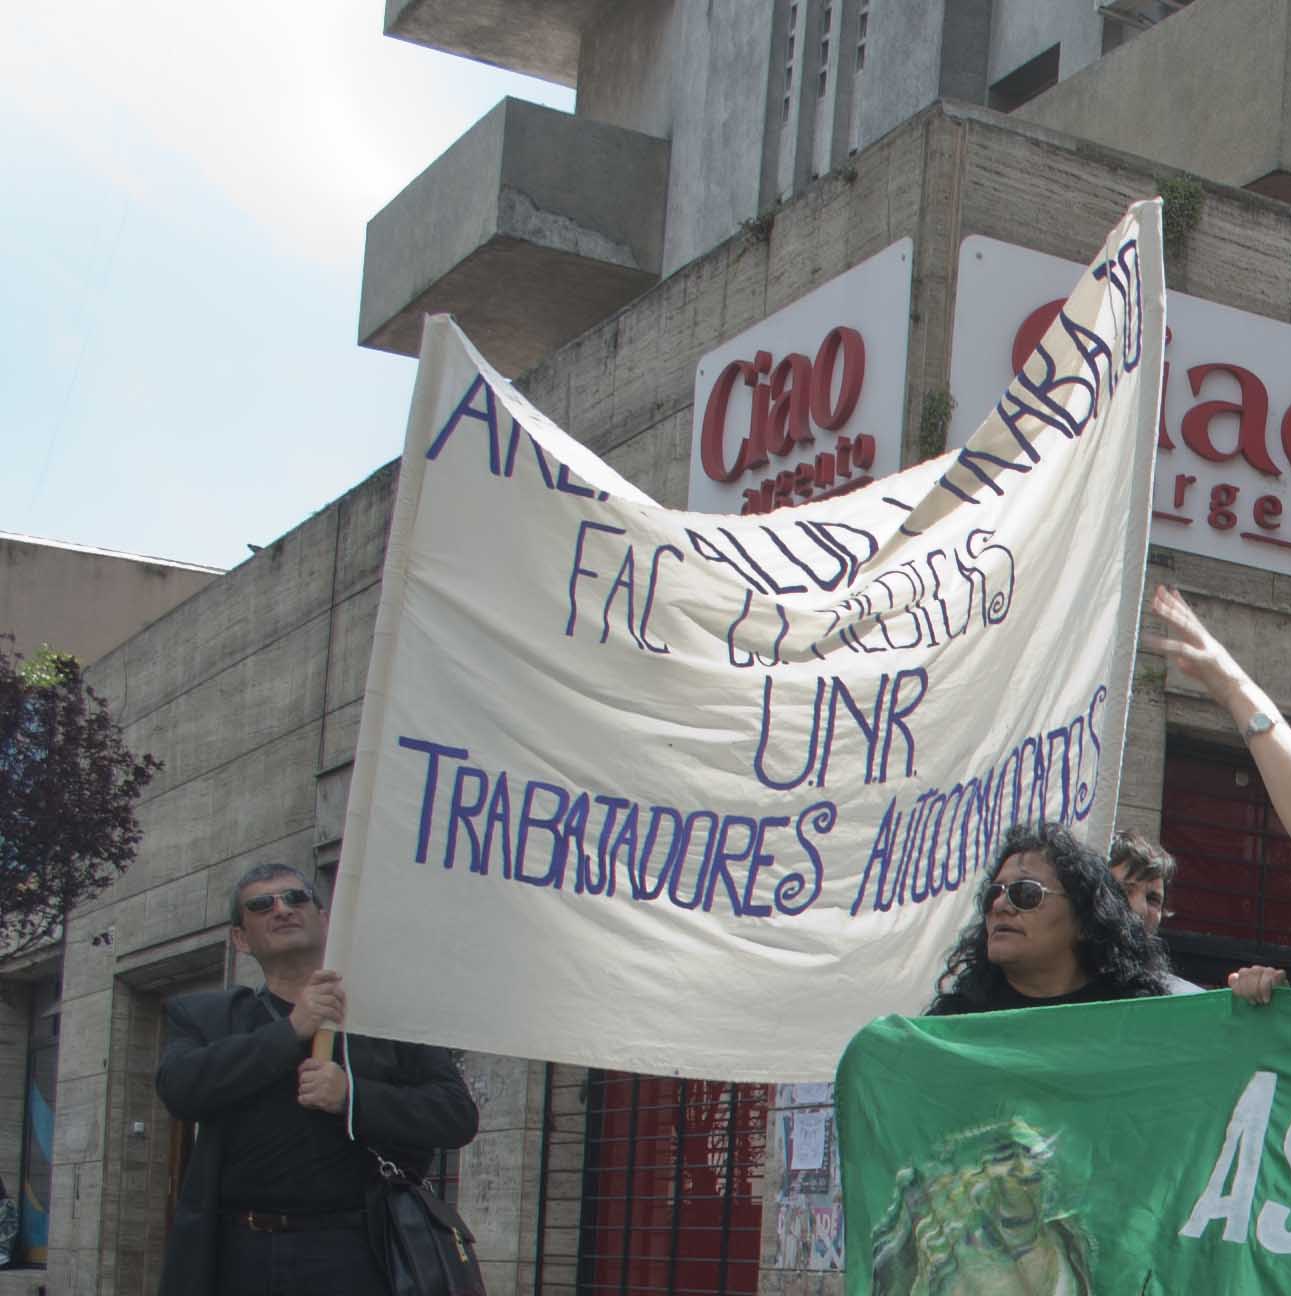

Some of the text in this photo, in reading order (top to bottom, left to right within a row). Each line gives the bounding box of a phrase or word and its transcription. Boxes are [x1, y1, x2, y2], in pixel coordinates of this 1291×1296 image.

[700, 326, 866, 484] Ciao
[565, 519, 684, 654] FAC
[398, 735, 837, 918] TRABAJADORES
